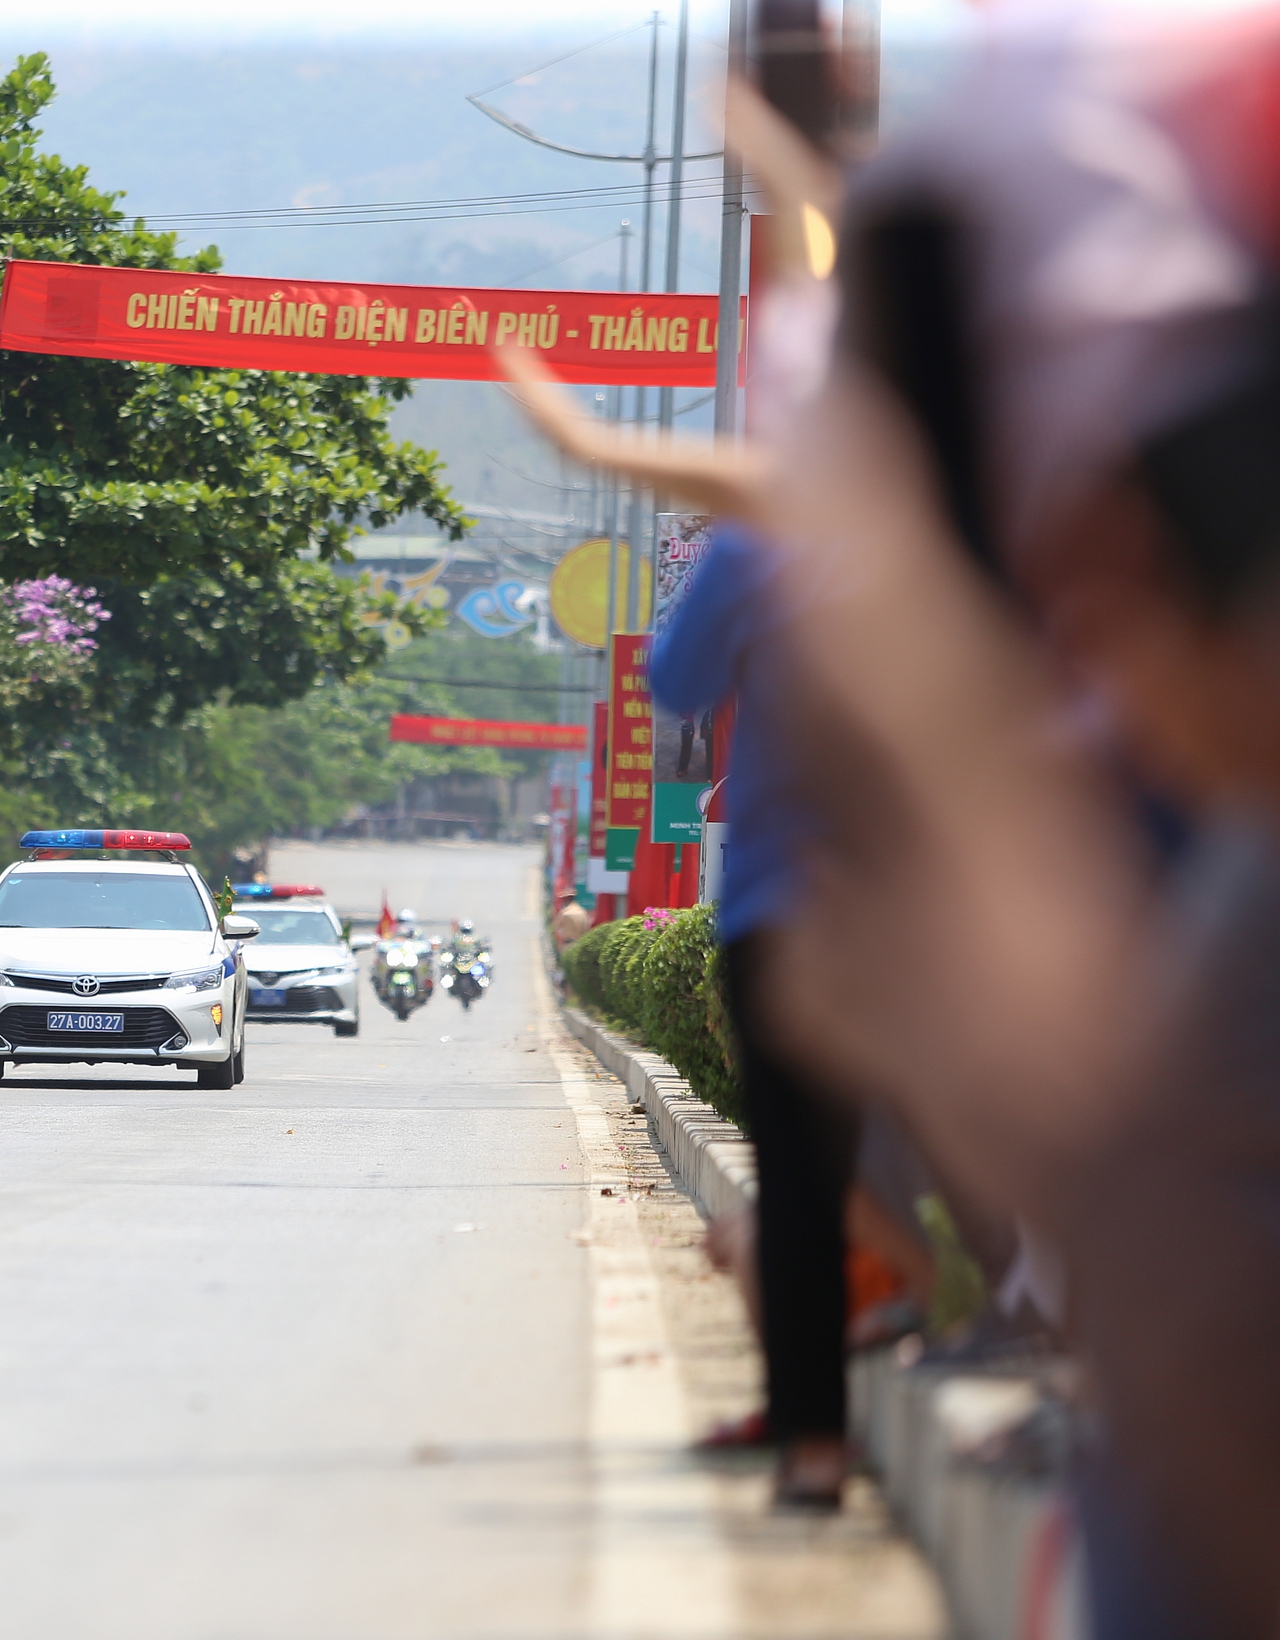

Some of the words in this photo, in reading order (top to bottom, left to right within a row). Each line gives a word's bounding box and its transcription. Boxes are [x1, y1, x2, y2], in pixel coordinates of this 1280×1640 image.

[125, 287, 219, 332] CHIẾN
[227, 290, 328, 338] THẮNG
[334, 299, 408, 347] ĐIỆN
[415, 302, 489, 346] BIÊN
[495, 304, 560, 350] PHỦ
[587, 307, 690, 354] THẮNG
[49, 1014, 121, 1030] 27A-003.27
